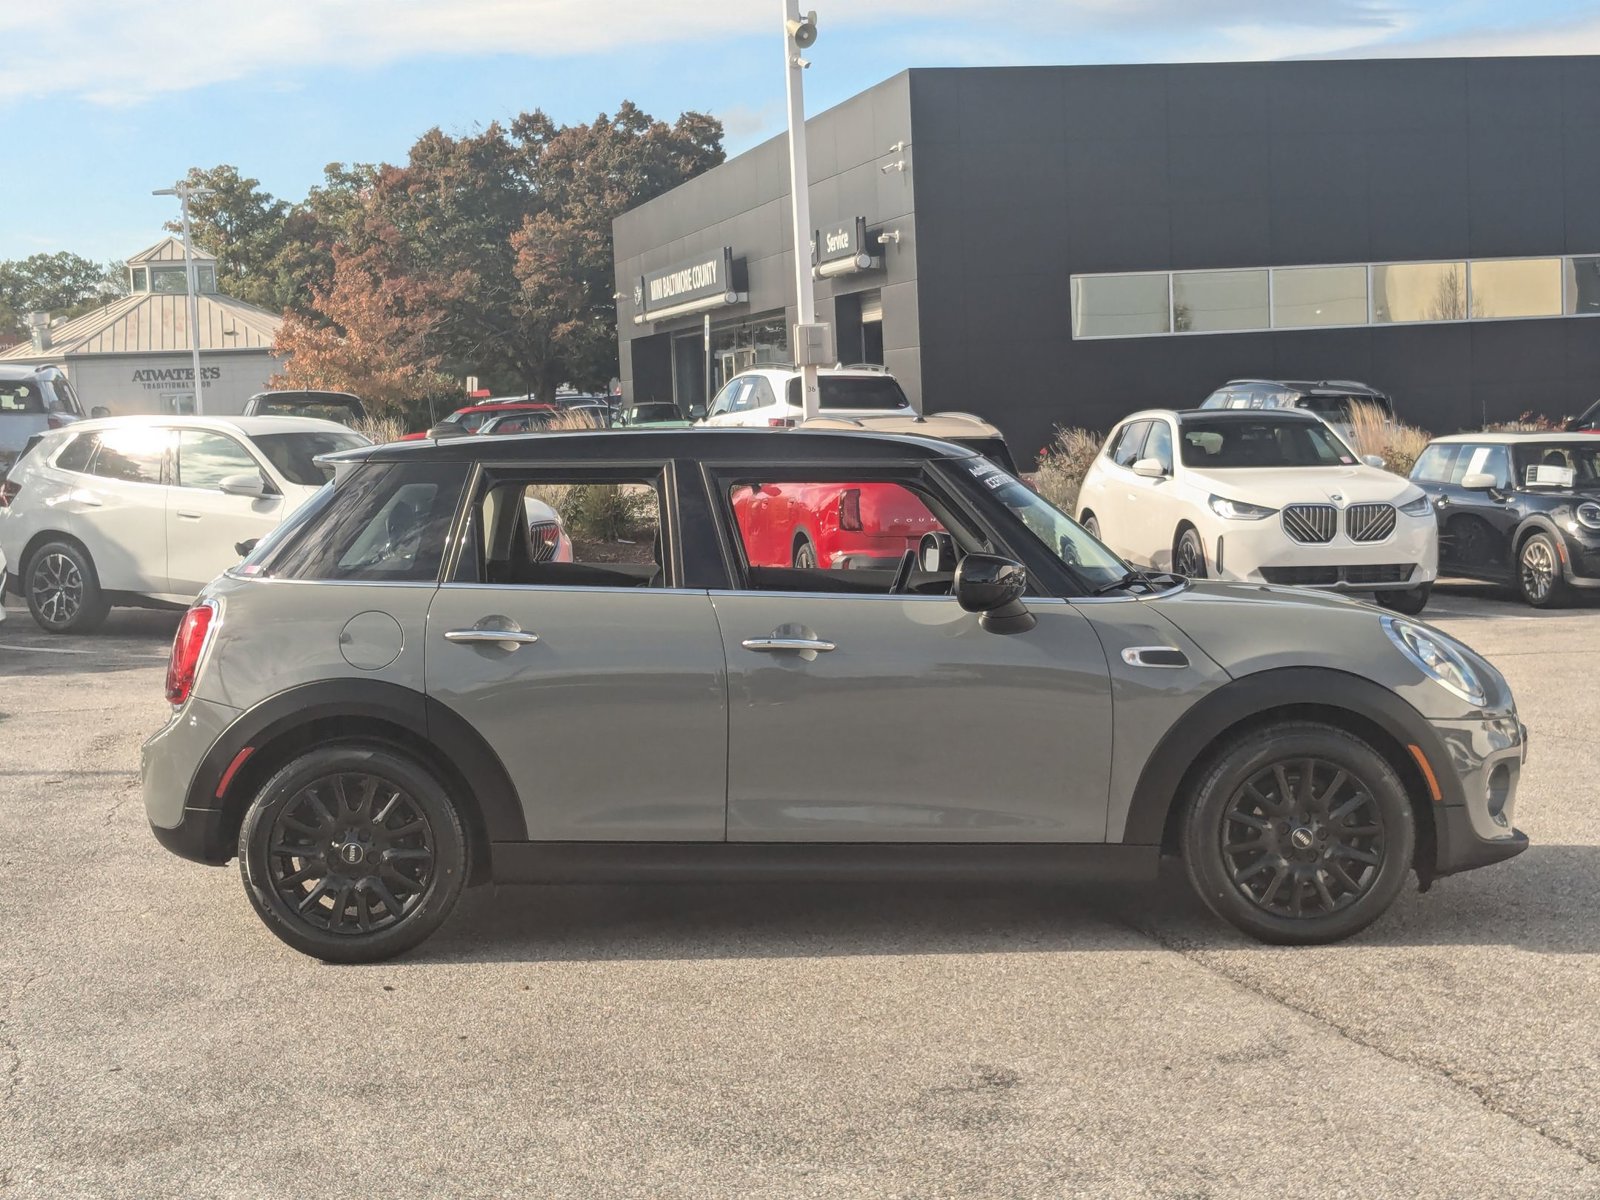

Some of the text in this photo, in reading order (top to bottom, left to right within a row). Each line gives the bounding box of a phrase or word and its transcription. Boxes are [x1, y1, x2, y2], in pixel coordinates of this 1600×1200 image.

[827, 229, 848, 252] Service
[650, 260, 716, 301] MINI BALTIMORE COUNTY
[132, 367, 220, 381] ATWATER'S
[143, 382, 189, 390] TRADITIONAL
